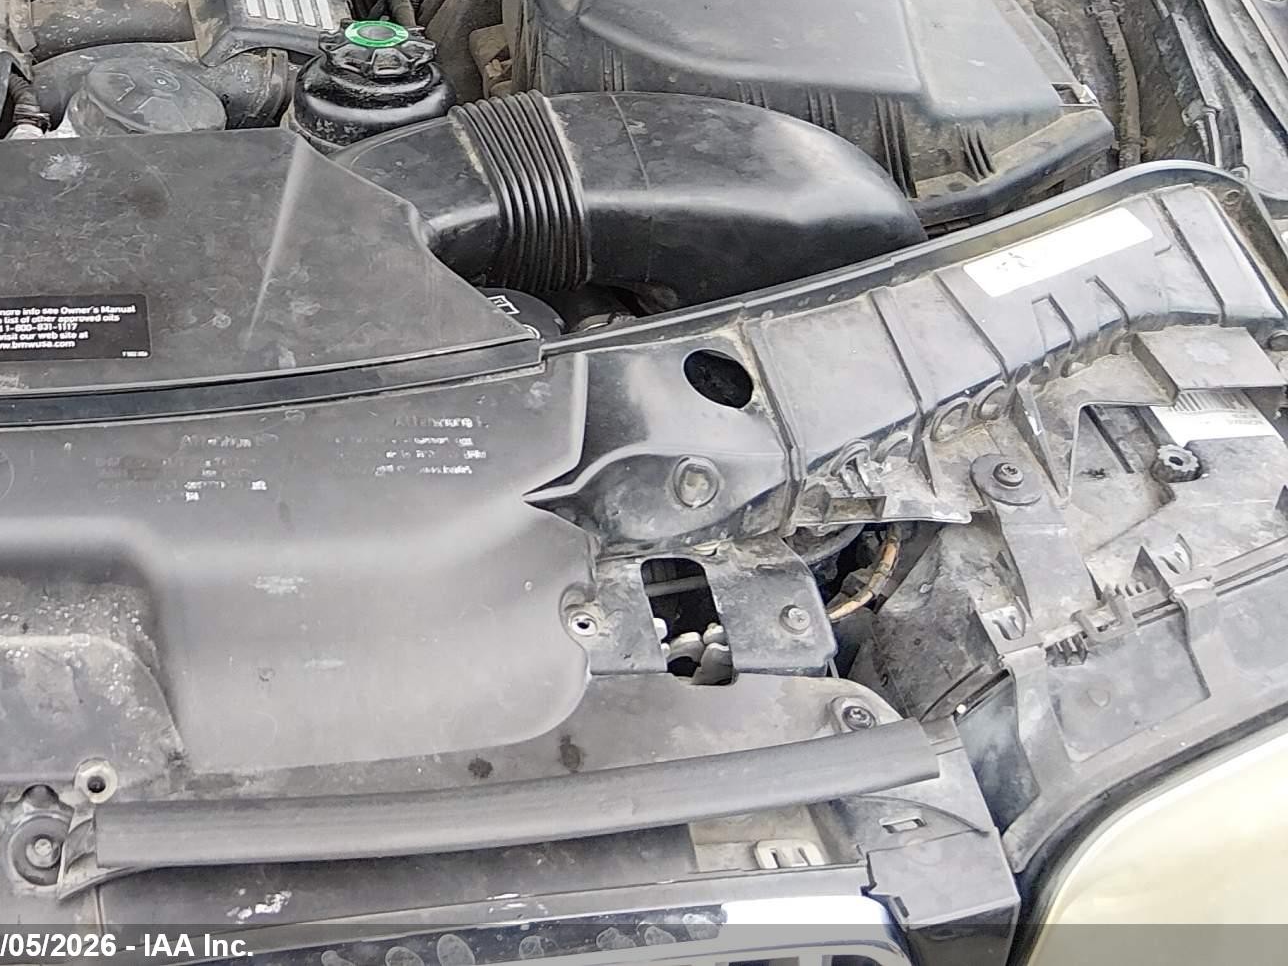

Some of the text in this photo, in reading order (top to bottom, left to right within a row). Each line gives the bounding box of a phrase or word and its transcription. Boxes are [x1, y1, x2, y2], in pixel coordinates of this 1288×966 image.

[100, 305, 136, 314] Manual
[4, 316, 19, 324] list
[20, 315, 31, 323] of
[31, 315, 55, 323] other
[57, 314, 101, 324] approved
[103, 313, 120, 321] oils
[36, 332, 58, 340] web
